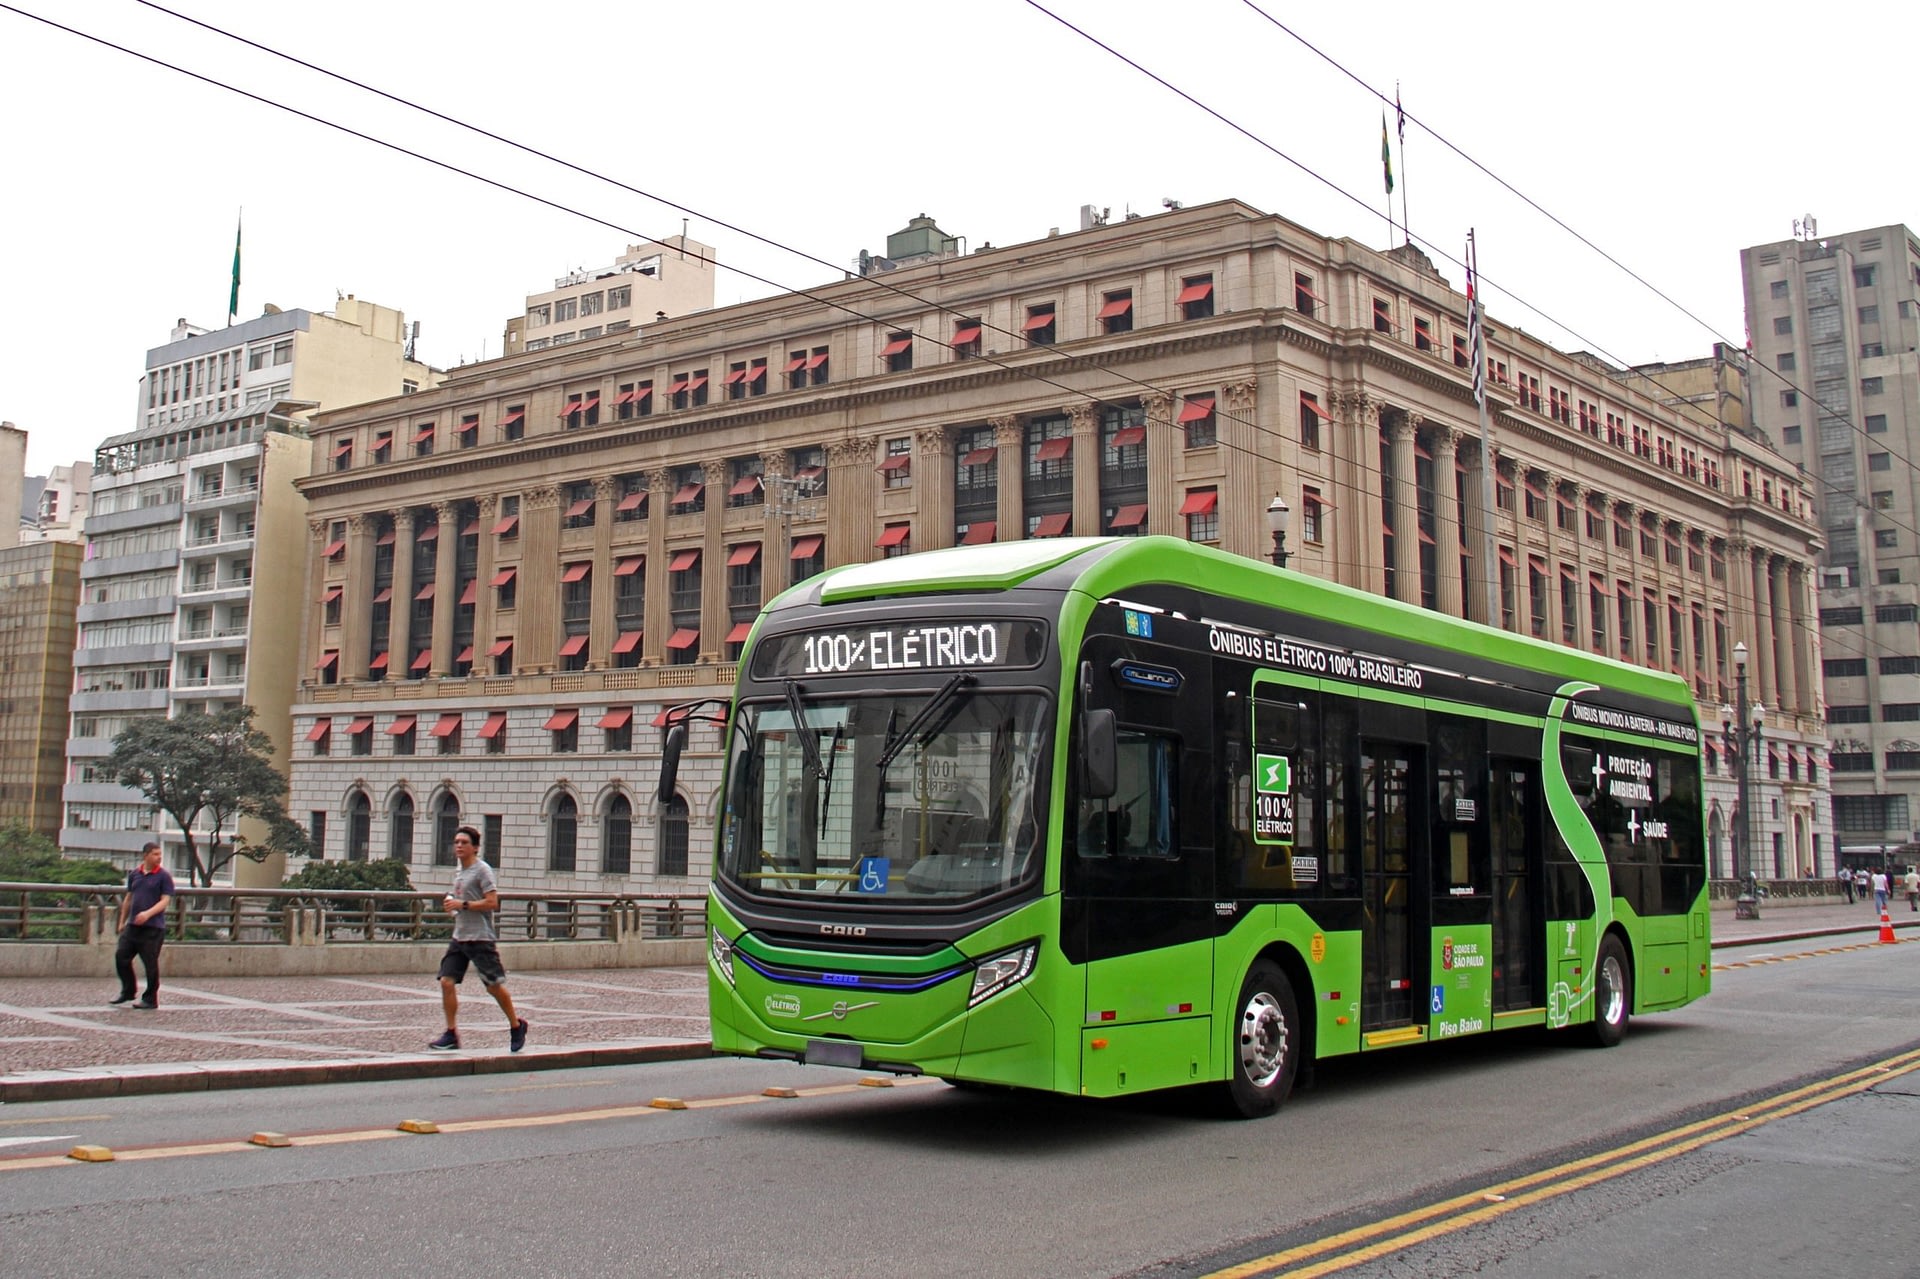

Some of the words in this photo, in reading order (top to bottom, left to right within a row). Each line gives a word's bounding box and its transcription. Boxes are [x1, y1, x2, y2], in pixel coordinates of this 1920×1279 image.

[805, 634, 865, 673] 100%
[870, 624, 997, 670] ELÉTRICO
[1209, 625, 1262, 659] ÔNIBUS
[1264, 639, 1326, 672] ELÉTRICO
[1328, 654, 1358, 679] 100%
[1359, 660, 1422, 689] BRASILEIRO
[1572, 701, 1598, 722] ÔNIBUS
[1598, 709, 1624, 730] MOVIDO
[1624, 715, 1630, 728] A
[1630, 716, 1655, 734] BATERIA
[1659, 722, 1667, 736] AR
[1667, 724, 1681, 739] MAIS
[1681, 726, 1697, 741] PURO
[1608, 755, 1652, 779] PROTEÇÃO
[1609, 780, 1653, 801] AMBIENTAL
[1256, 795, 1293, 819] 100%
[1256, 817, 1293, 834] ELÉTRICO
[1642, 819, 1668, 839] SAÚDE
[1453, 945, 1470, 954] CIDADE
[1470, 943, 1477, 954] DE
[1453, 955, 1466, 968] SÃO
[1466, 956, 1484, 967] PAULO
[1440, 1021, 1457, 1036] Piso
[1459, 1017, 1482, 1033] Baixo
